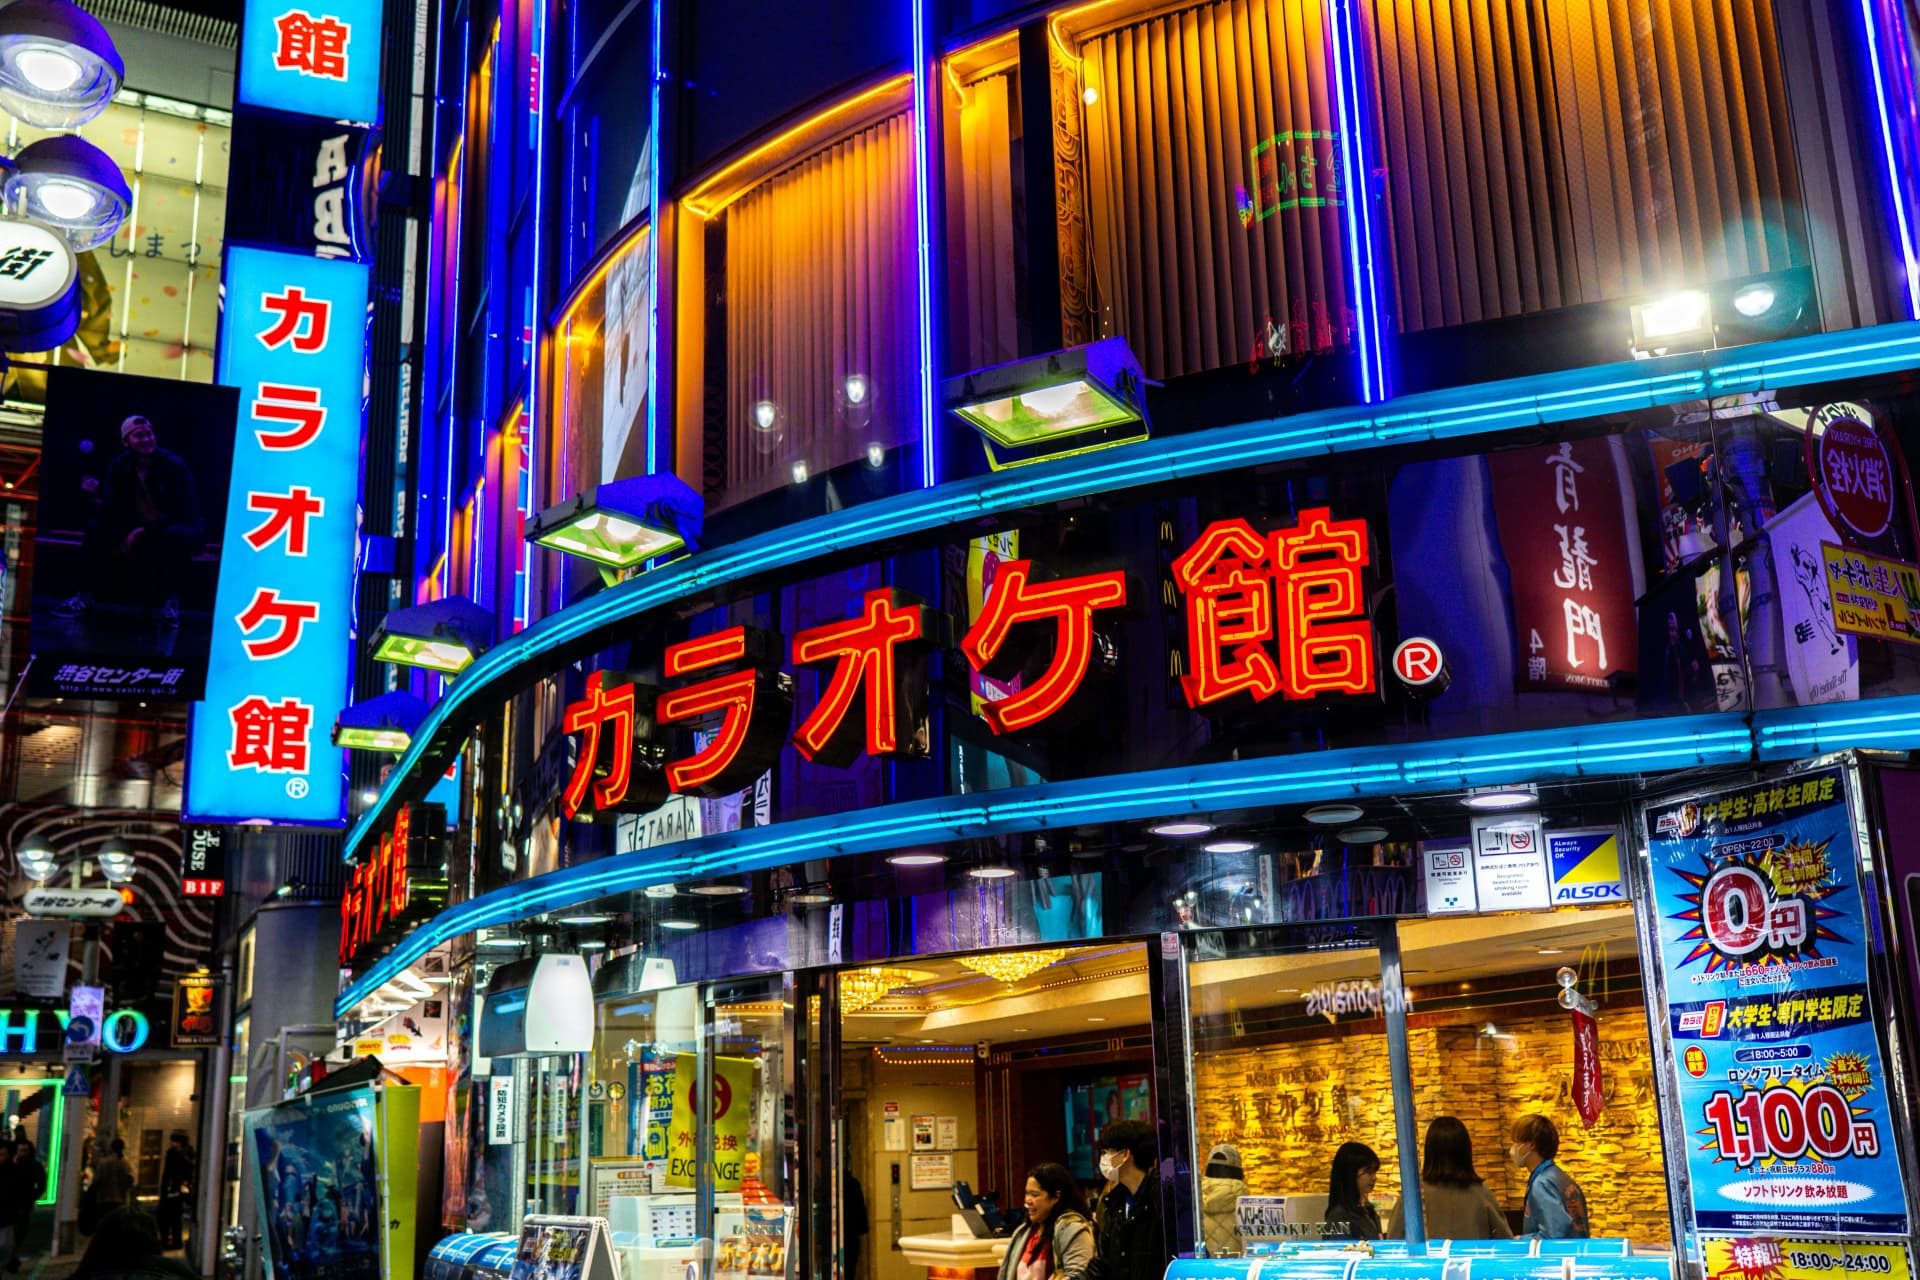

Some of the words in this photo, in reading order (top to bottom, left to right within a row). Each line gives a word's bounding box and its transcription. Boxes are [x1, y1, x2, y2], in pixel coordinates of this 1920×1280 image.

[274, 10, 348, 81] 館
[226, 286, 332, 775] カラオケ館
[54, 664, 185, 685] 渋谷センター街
[561, 507, 1377, 821] カラオケ館
[1556, 884, 1622, 900] ALSOK
[1705, 869, 1806, 953] 0円
[0, 1009, 149, 1052] HO
[1728, 1063, 1825, 1083] ロングフリータイム
[1706, 1086, 1877, 1164] 1,100円
[671, 1158, 740, 1182] EXCNGE
[1233, 1222, 1312, 1237] KARAOKE
[1734, 1242, 1783, 1270] 特報!!
